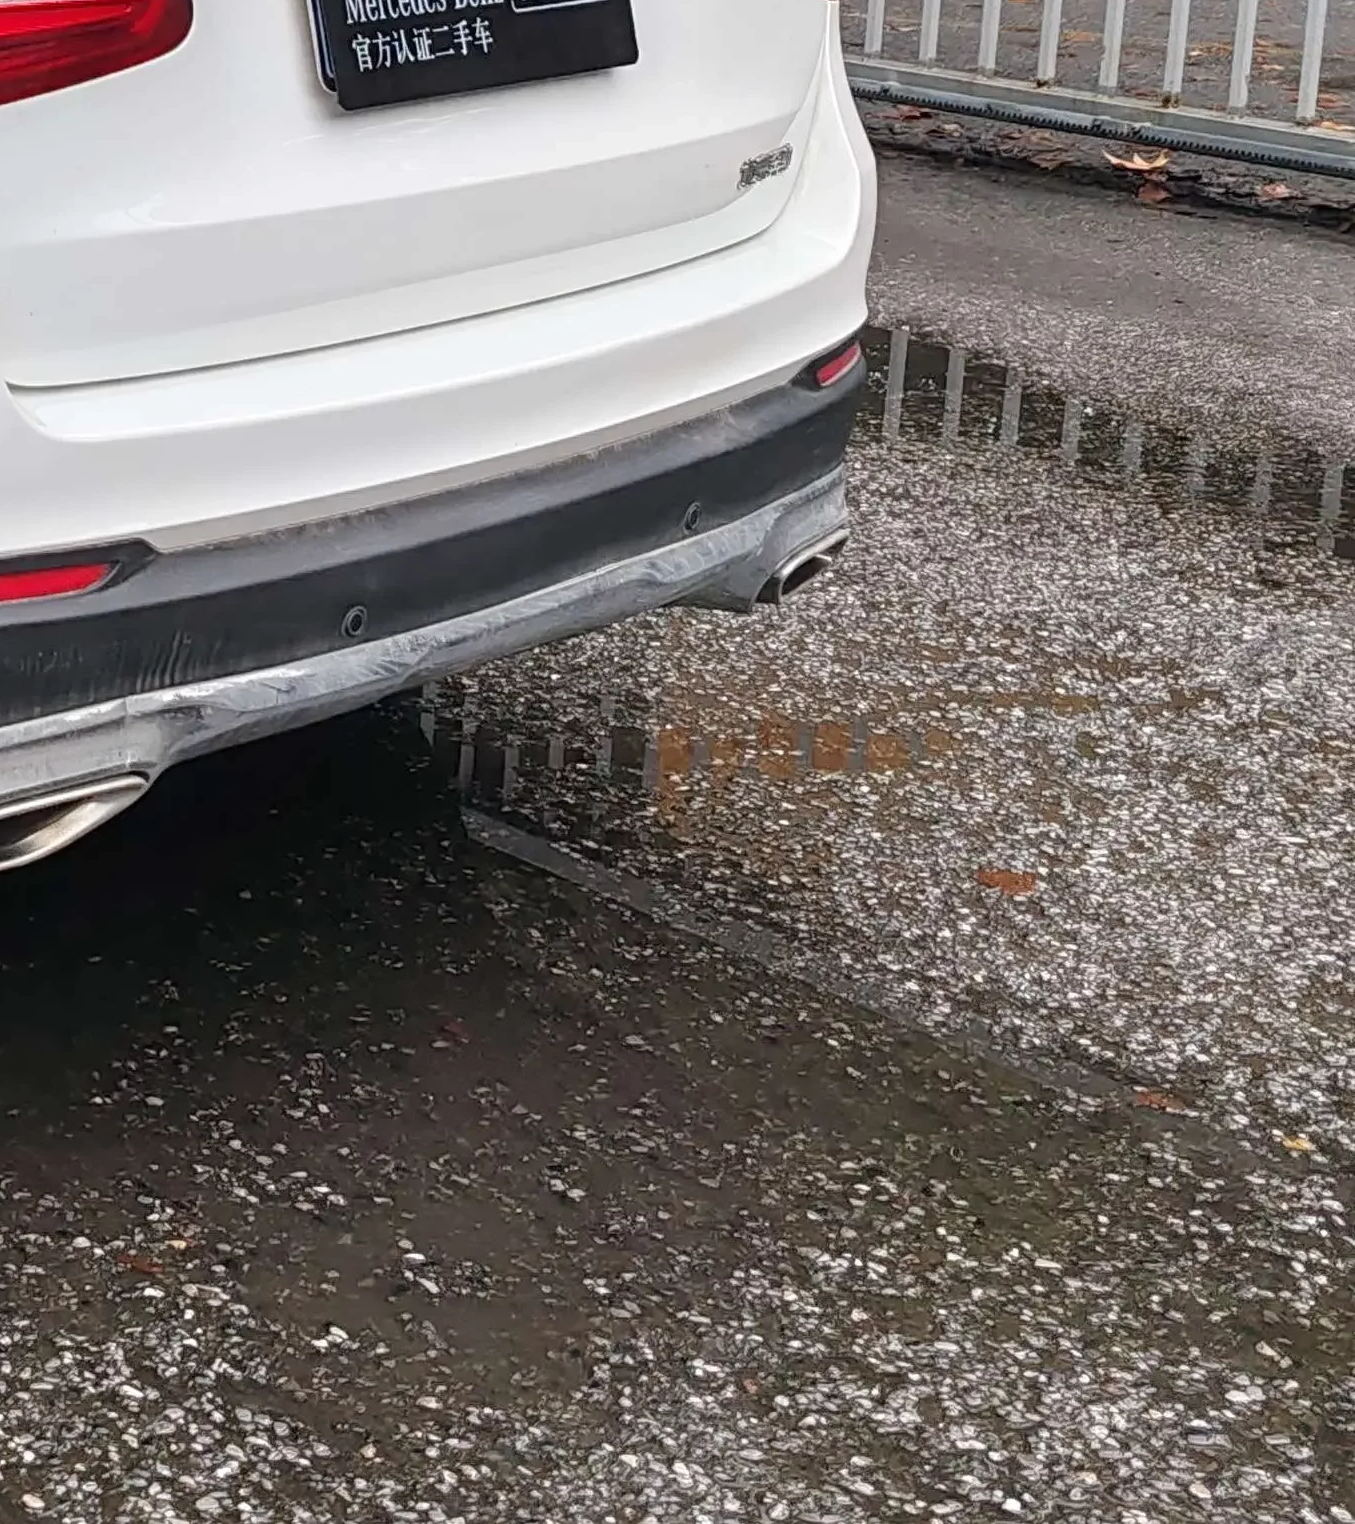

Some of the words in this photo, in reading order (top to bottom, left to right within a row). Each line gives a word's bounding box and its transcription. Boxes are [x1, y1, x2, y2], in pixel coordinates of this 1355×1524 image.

[352, 17, 494, 73] 官方认证二手车
